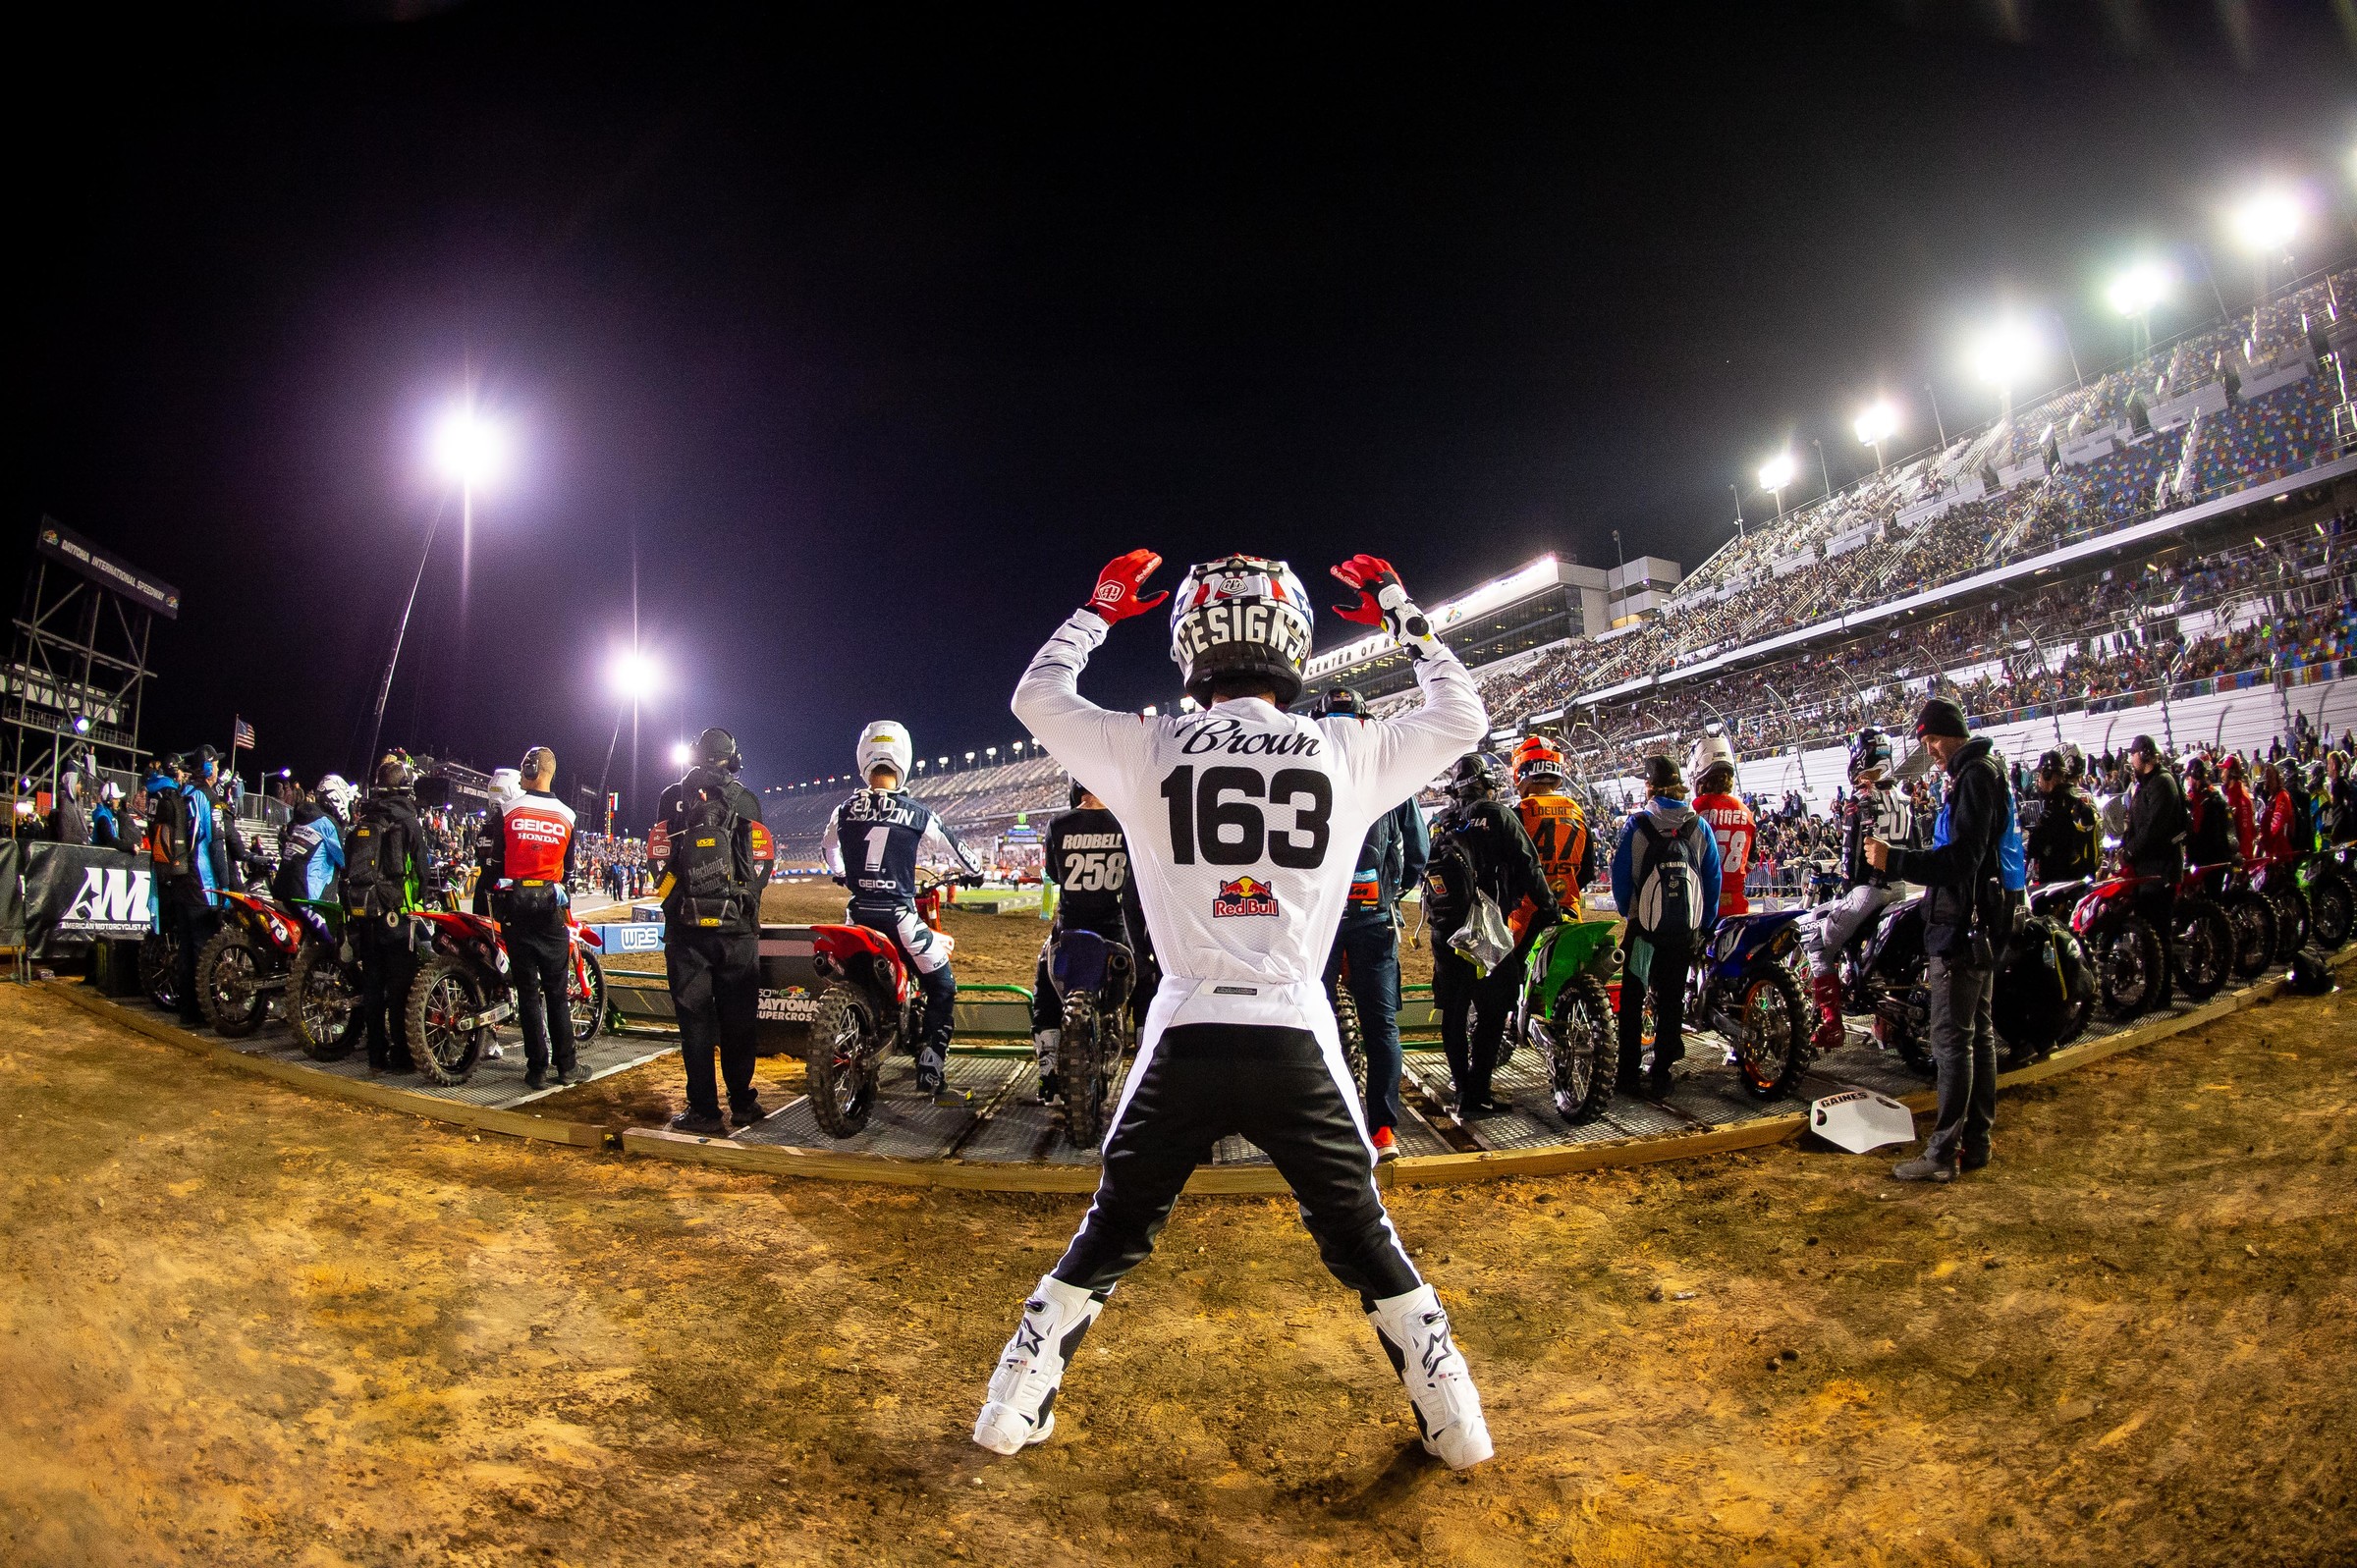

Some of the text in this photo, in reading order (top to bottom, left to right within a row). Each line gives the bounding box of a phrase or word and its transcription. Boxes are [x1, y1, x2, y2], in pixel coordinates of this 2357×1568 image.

[61, 539, 165, 601] DAYTONA INTERNATIONAL SPEEDWAY
[1308, 651, 1352, 676] CENTER
[1360, 642, 1375, 657] OF
[1175, 718, 1320, 757] Brown
[511, 818, 566, 838] GEICO
[1161, 764, 1333, 870] 163
[517, 832, 560, 845] HONDA
[863, 826, 891, 872] 1
[1062, 833, 1123, 850] RODBELL
[1533, 817, 1580, 862] 47
[857, 879, 898, 890] GEICO
[1064, 852, 1127, 892] 258
[1215, 898, 1278, 917] Red Bull
[621, 928, 658, 950] WPS
[1821, 1092, 1867, 1108] GAINES
